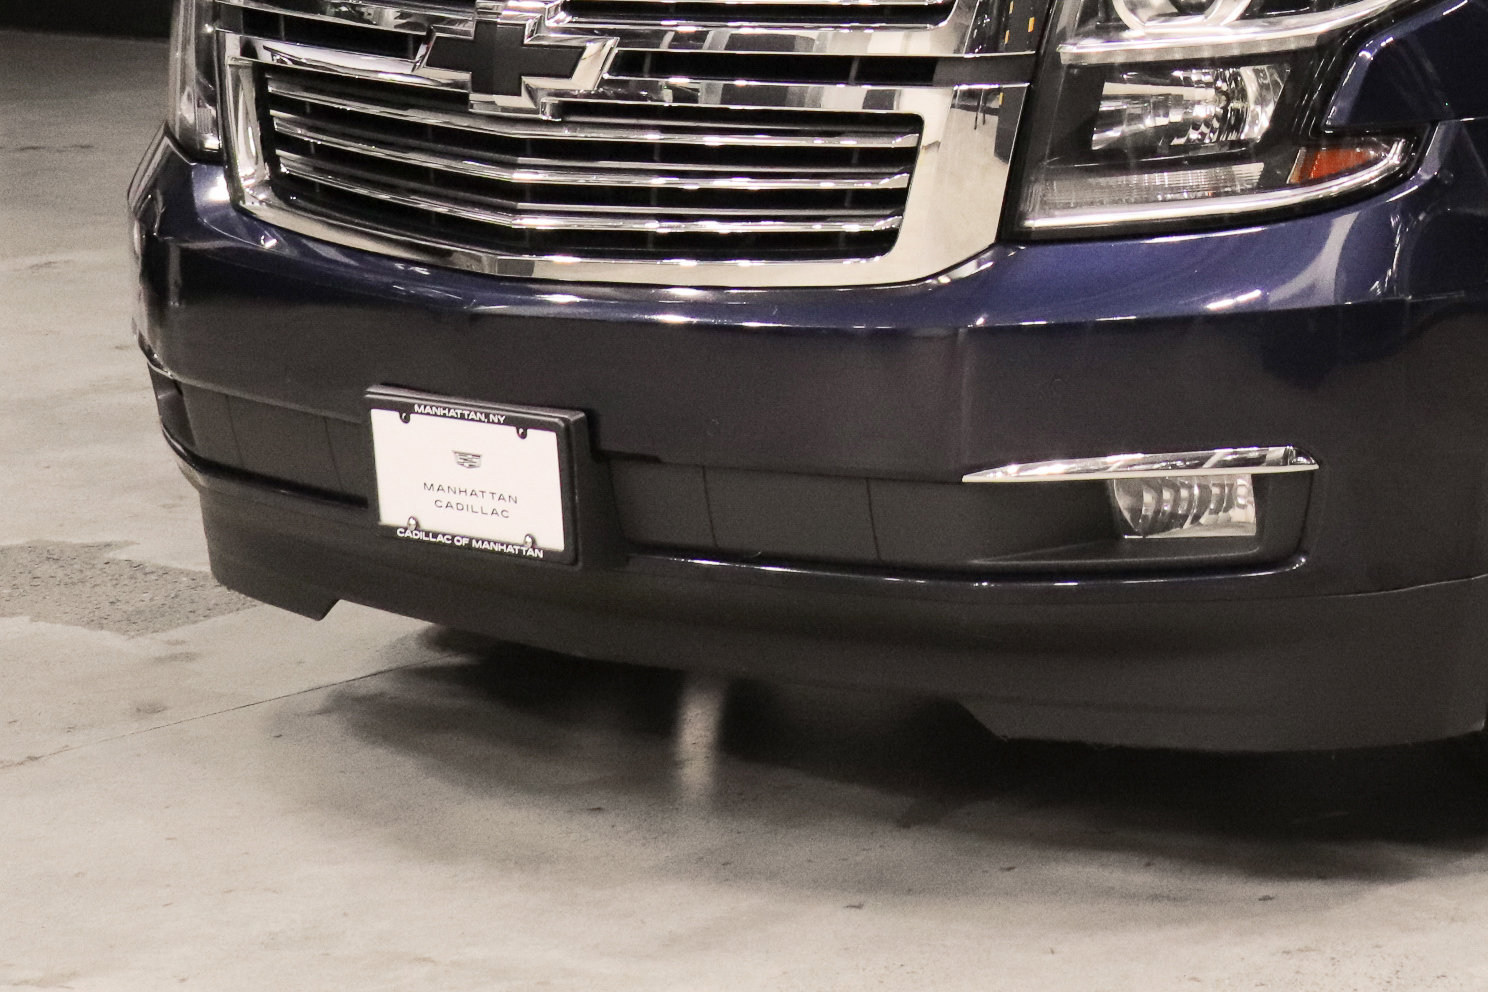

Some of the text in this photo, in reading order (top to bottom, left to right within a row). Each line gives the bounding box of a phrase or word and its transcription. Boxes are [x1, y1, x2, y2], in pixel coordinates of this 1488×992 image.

[413, 404, 506, 424] MANHATTAN, NY
[423, 482, 519, 504] MANHATTAN
[434, 499, 511, 519] CADILLAC
[396, 527, 544, 558] CADILLAC OF MANHATTAN
